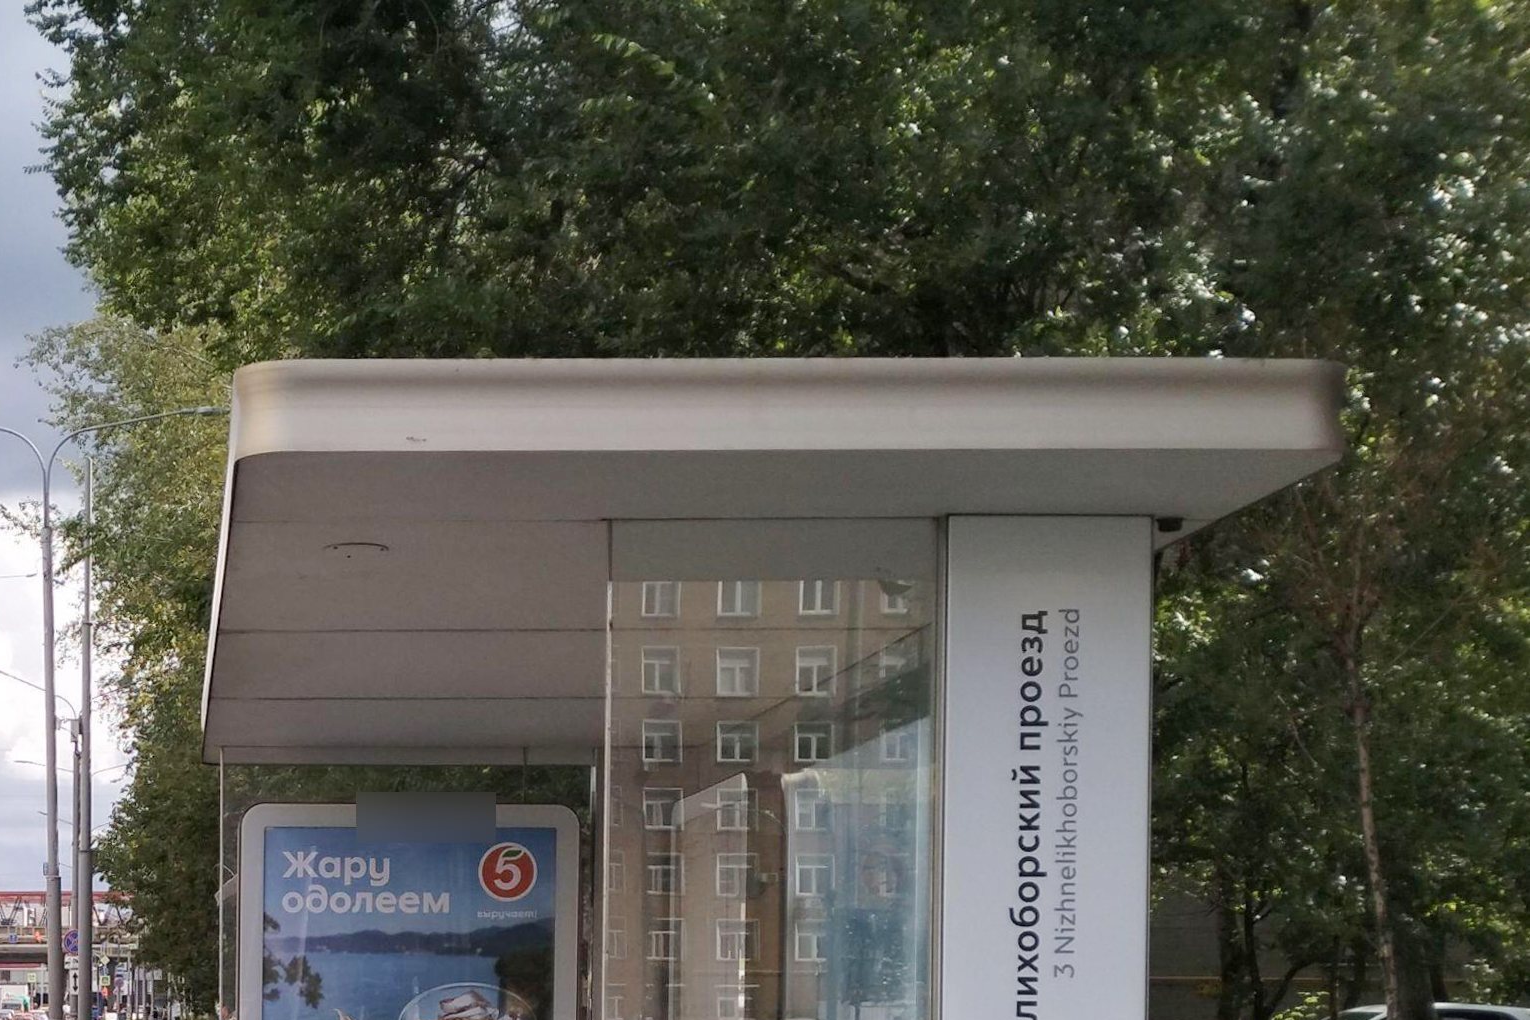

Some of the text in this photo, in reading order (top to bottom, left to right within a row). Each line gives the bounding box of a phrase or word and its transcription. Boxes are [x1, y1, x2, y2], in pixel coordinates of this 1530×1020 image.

[1020, 610, 1049, 751] проезд
[1053, 608, 1084, 979] 3 Nizhnelikhoborskiy Proezd
[281, 884, 450, 914] одолеем
[282, 851, 390, 886] Жару
